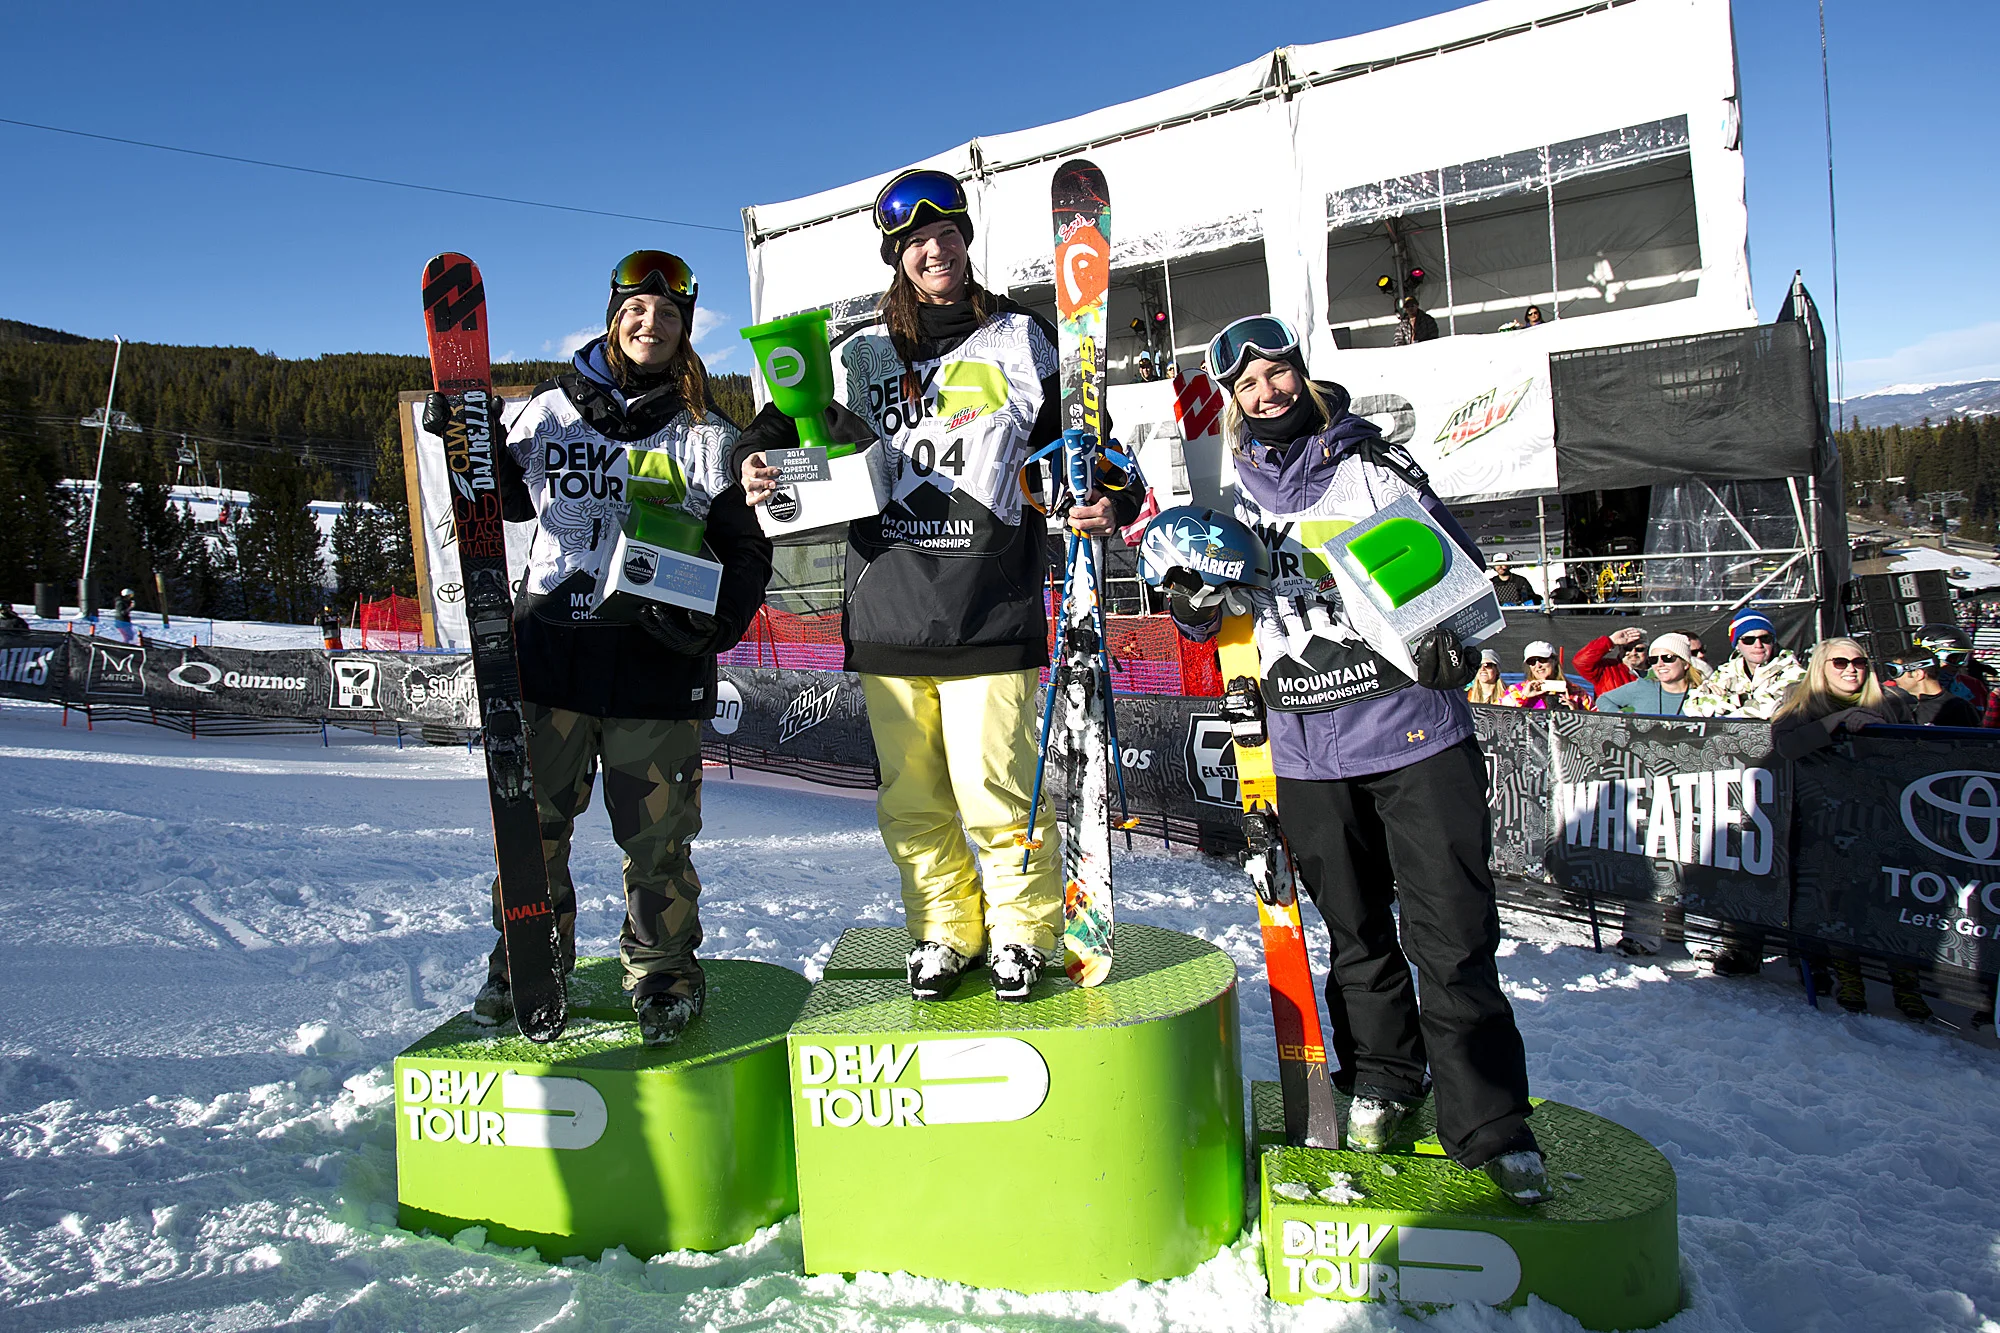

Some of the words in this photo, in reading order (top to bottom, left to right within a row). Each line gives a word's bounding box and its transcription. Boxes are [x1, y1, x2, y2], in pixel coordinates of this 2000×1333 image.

[438, 378, 489, 389] HESTRA
[545, 441, 626, 474] DEW
[783, 457, 811, 466] FREESKI
[786, 450, 805, 458] 2014
[545, 471, 624, 502] TOUR
[778, 472, 819, 482] CHAMPION
[454, 493, 499, 522] OLD
[457, 519, 502, 542] CLASS
[881, 513, 975, 536] MOUNTAIN
[460, 541, 503, 558] MATES
[881, 528, 972, 549] CHAMPIONSHIPS
[1190, 547, 1246, 580] MARKER
[1271, 551, 1303, 581] UR
[1283, 578, 1304, 587] BUILT
[1454, 610, 1481, 628] FREESKI
[1459, 611, 1489, 634] OPESTYLE
[100, 673, 135, 682] MITCH
[223, 671, 307, 690] Quiznos
[1277, 659, 1378, 693] MOUNTAIN
[1281, 680, 1380, 706] CHAMPIONSHIPS
[1201, 765, 1239, 779] ELEV
[1562, 767, 1774, 876] WHEATIES
[1881, 865, 2000, 916] TOYO
[505, 901, 552, 922] WALL
[1899, 908, 1950, 932] Let's
[1955, 917, 1988, 938] Go
[798, 1043, 919, 1085] DEW
[1279, 1044, 1327, 1062] LEDGE
[403, 1068, 499, 1106] DEW
[801, 1087, 926, 1128] TOUR
[403, 1106, 505, 1147] TOUR
[1283, 1219, 1394, 1259] DEW
[1282, 1257, 1400, 1301] TOUR
